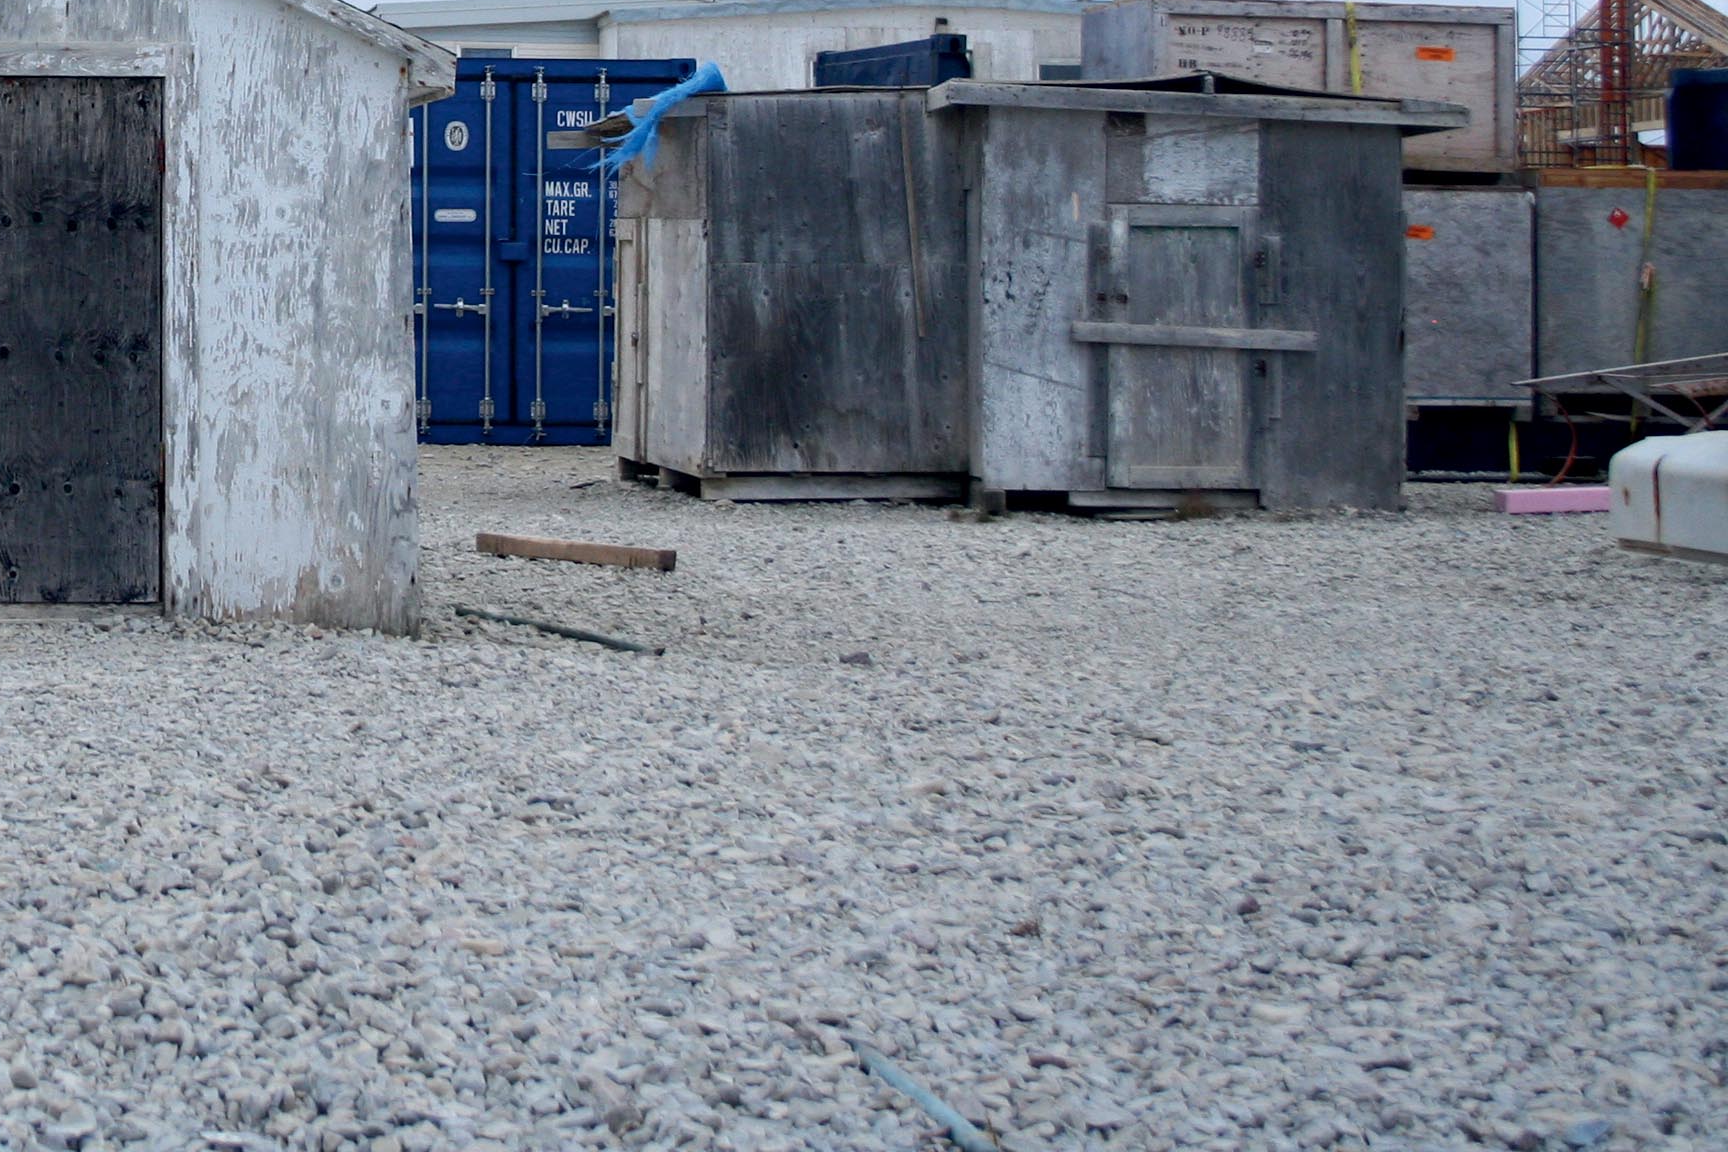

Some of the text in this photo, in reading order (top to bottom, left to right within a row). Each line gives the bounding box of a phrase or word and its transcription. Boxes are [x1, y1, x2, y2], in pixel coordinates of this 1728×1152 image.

[545, 181, 592, 198] MAX.GR.
[546, 200, 575, 217] TARE
[545, 219, 568, 235] NET
[544, 238, 591, 254] CU.CAP.
